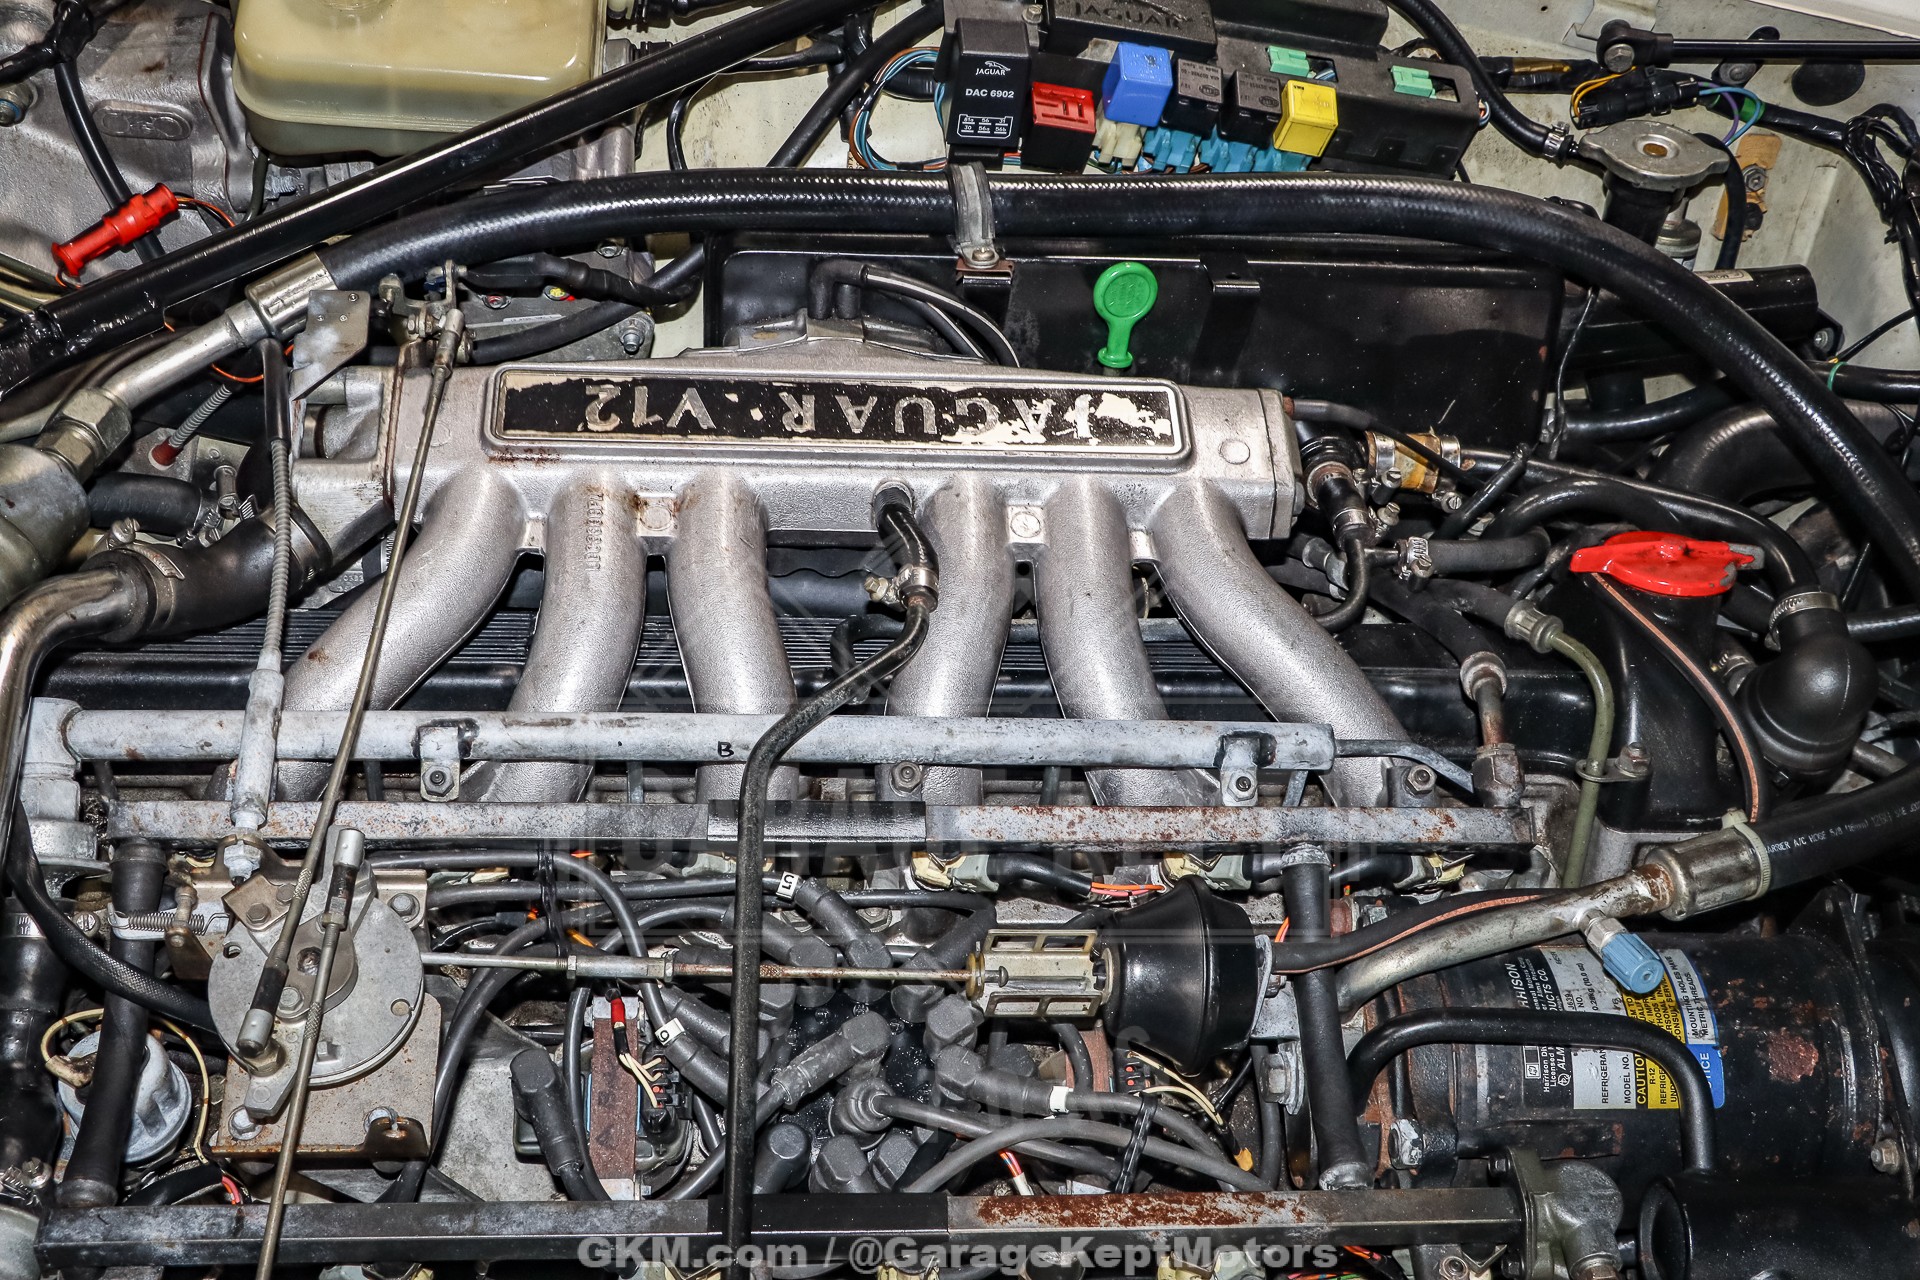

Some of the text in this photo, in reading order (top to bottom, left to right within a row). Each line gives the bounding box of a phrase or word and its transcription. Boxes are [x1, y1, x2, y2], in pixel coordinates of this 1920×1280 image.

[975, 68, 1006, 76] JAGUAR
[965, 88, 1015, 98] DAC 6902
[585, 384, 1095, 441] JAGUAR V12
[717, 741, 735, 757] B
[1765, 841, 1791, 854] ARRIER
[1793, 837, 1807, 848] A/C
[1505, 963, 1530, 1009] RRISON
[1537, 968, 1549, 982] CO.
[1530, 990, 1540, 1010] eneral
[1542, 983, 1558, 1011] UCTS
[1575, 994, 1585, 1008] NO.
[1643, 998, 1653, 1017] IMPR
[1664, 955, 1698, 1036] MOUNTING HOLES HAVE
[1684, 971, 1709, 1036] METRIC THREADS.
[1652, 1002, 1664, 1027] THODS
[1659, 999, 1673, 1033] RSONAL
[1549, 1052, 1557, 1087] Licensed
[1555, 1046, 1567, 1071] ALM
[1699, 1052, 1712, 1089] TICE
[1542, 1059, 1550, 1093] Harrison
[1599, 1049, 1609, 1104] REFRIGERAN
[1621, 1054, 1632, 1104] MODEL NO.
[1634, 1053, 1647, 1105] CAUTIO
[1648, 1067, 1656, 1085] R-12
[1659, 1069, 1667, 1105] REFRIGE
[1670, 1083, 1678, 1103] UND
